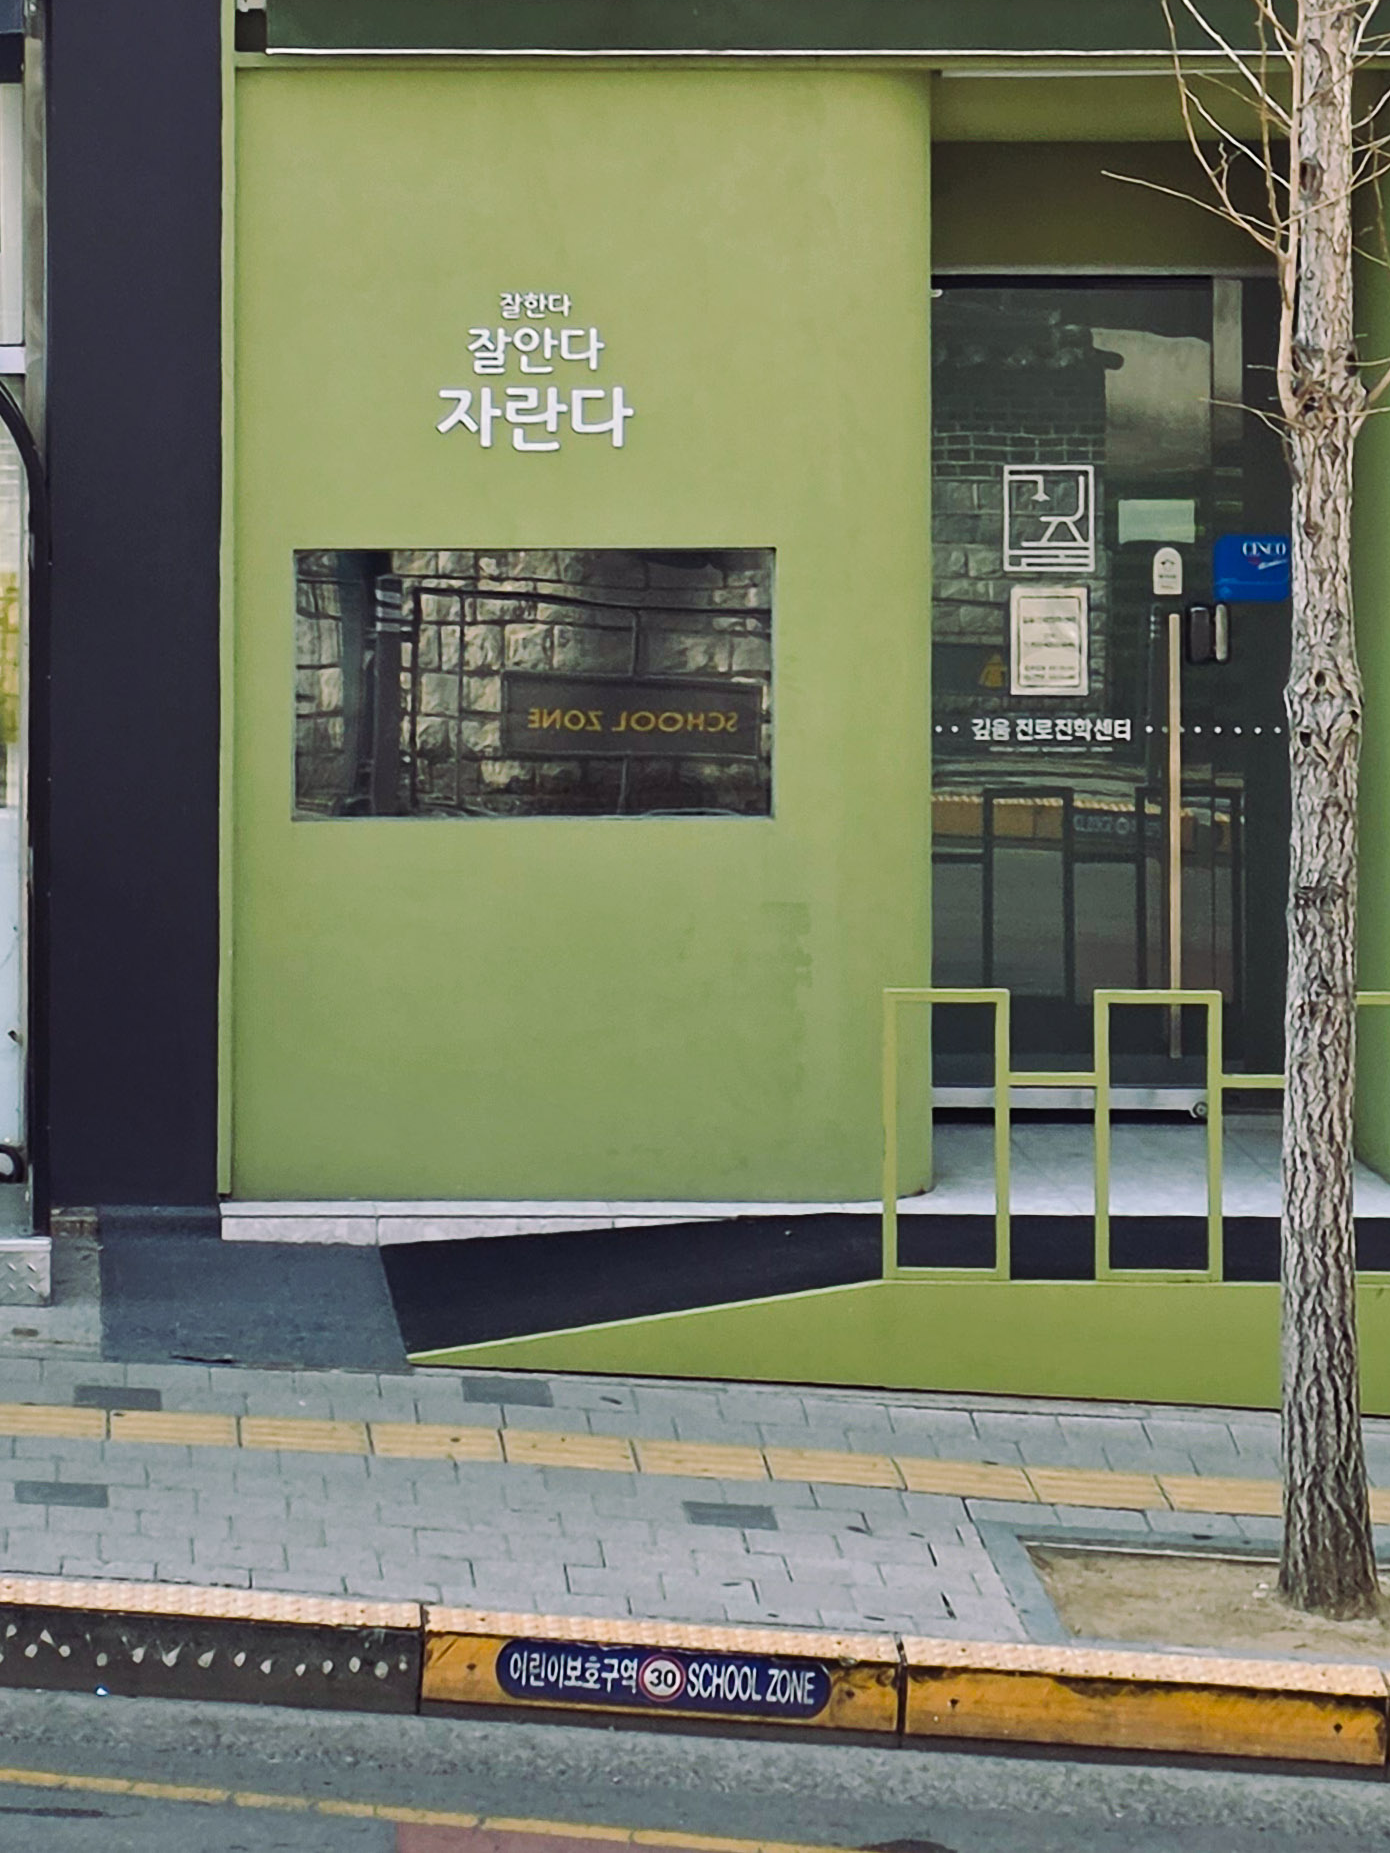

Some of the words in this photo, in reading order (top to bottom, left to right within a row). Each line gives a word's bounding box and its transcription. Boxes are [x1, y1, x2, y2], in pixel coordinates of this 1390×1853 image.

[500, 292, 572, 319] 잘한다
[466, 326, 606, 375] 잘안다
[435, 385, 635, 452] 자란다
[1015, 717, 1132, 743] 진로진학센터
[648, 1667, 677, 1691] 30
[686, 1662, 763, 1703] SCHOOL
[765, 1668, 816, 1705] ZONE
